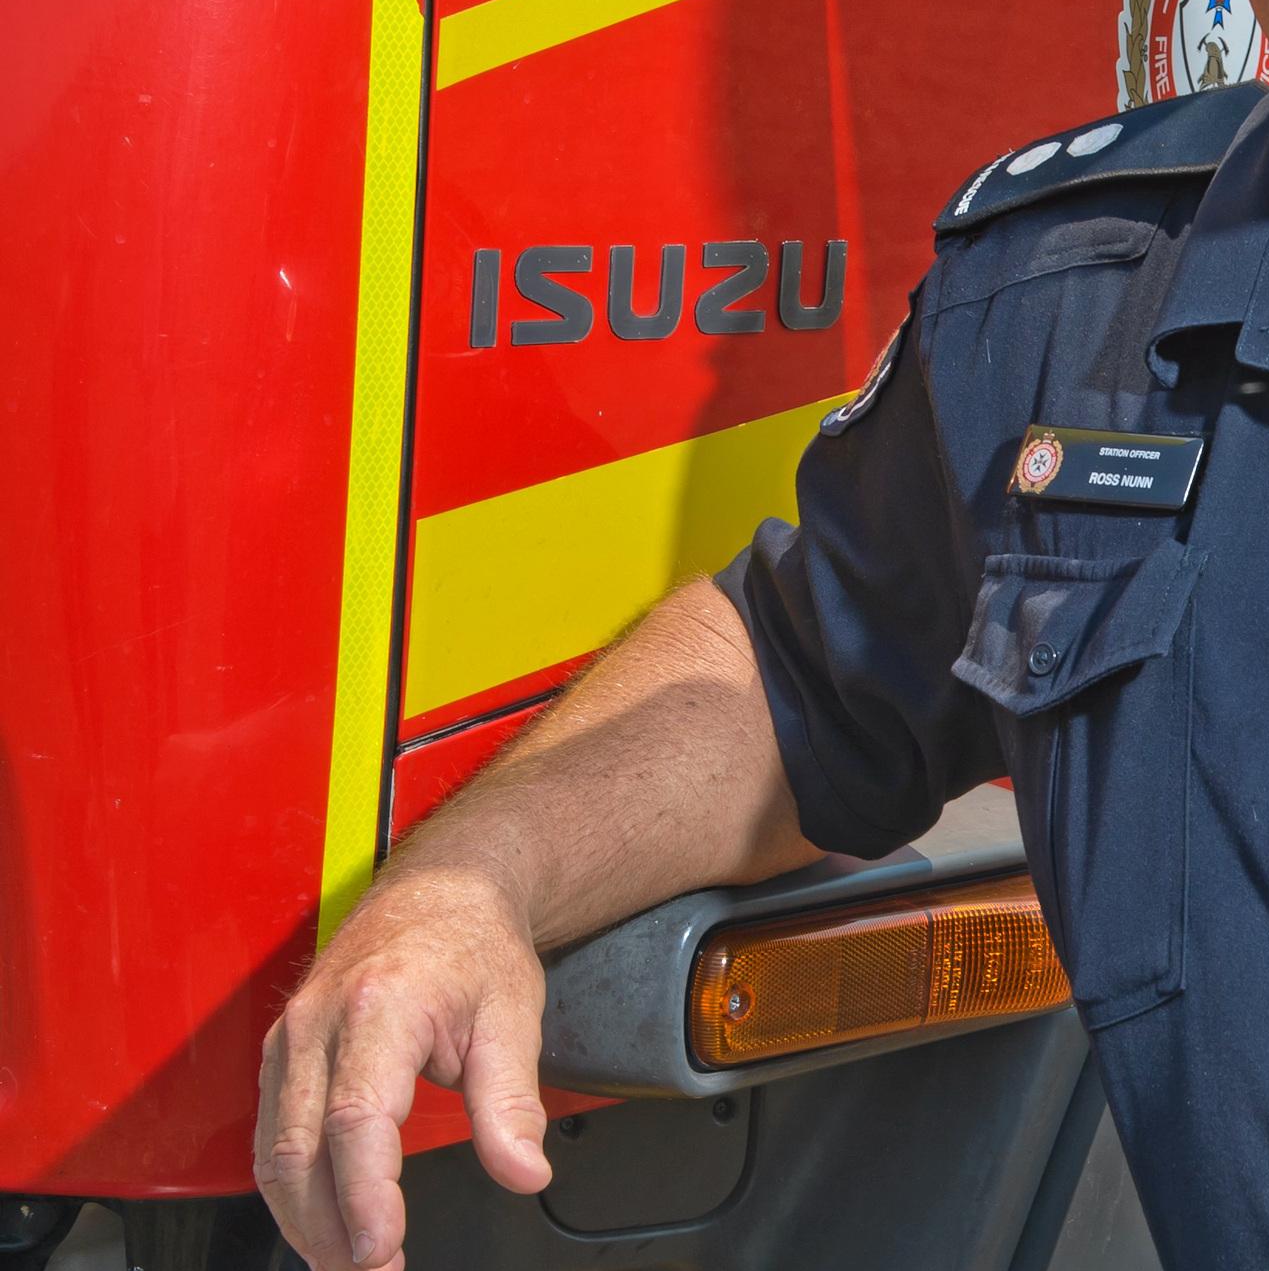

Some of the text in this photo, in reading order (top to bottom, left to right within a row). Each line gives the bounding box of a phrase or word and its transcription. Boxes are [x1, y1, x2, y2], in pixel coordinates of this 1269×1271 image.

[1153, 35, 1171, 99] FIRE
[470, 239, 847, 349] ISUZU
[1098, 446, 1161, 460] STATION OFFICER
[1088, 471, 1154, 489] ROSS NUNN
